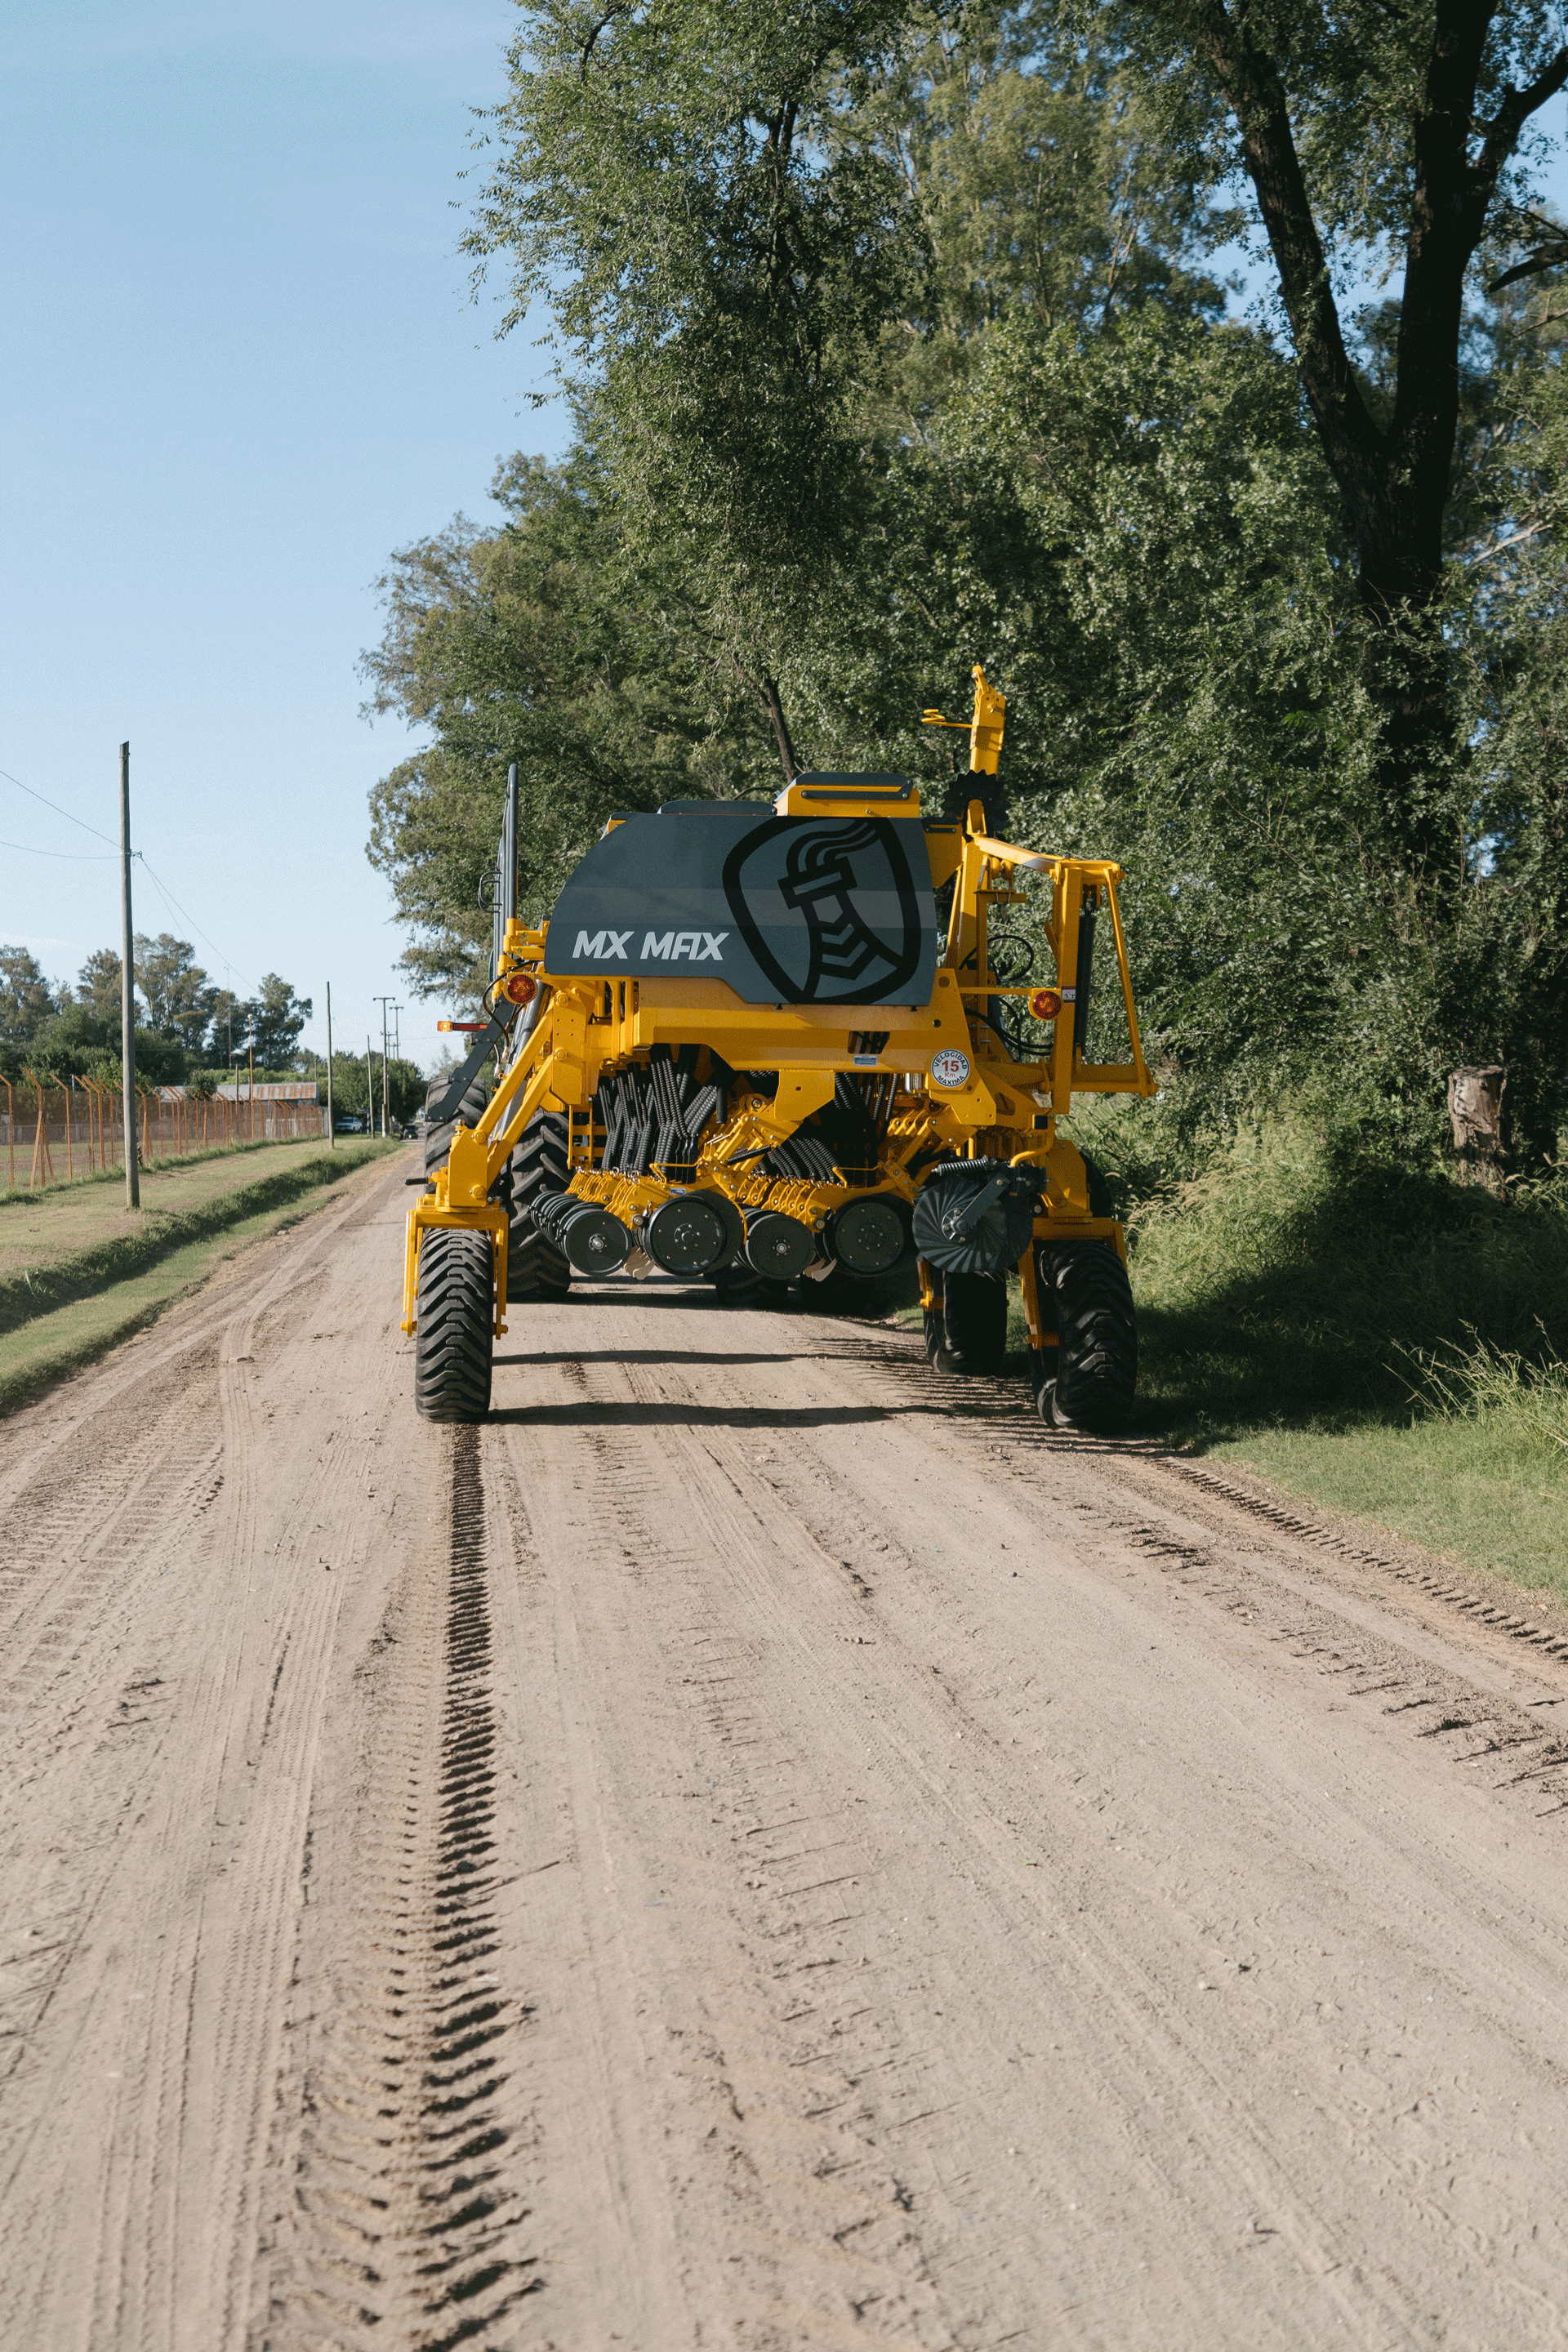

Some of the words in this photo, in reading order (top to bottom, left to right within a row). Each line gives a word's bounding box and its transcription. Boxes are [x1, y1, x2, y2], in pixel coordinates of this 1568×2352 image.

[572, 930, 635, 959] MX
[640, 932, 729, 960] MAX
[933, 1052, 967, 1069] VELOCIDAD
[942, 1060, 959, 1071] 15
